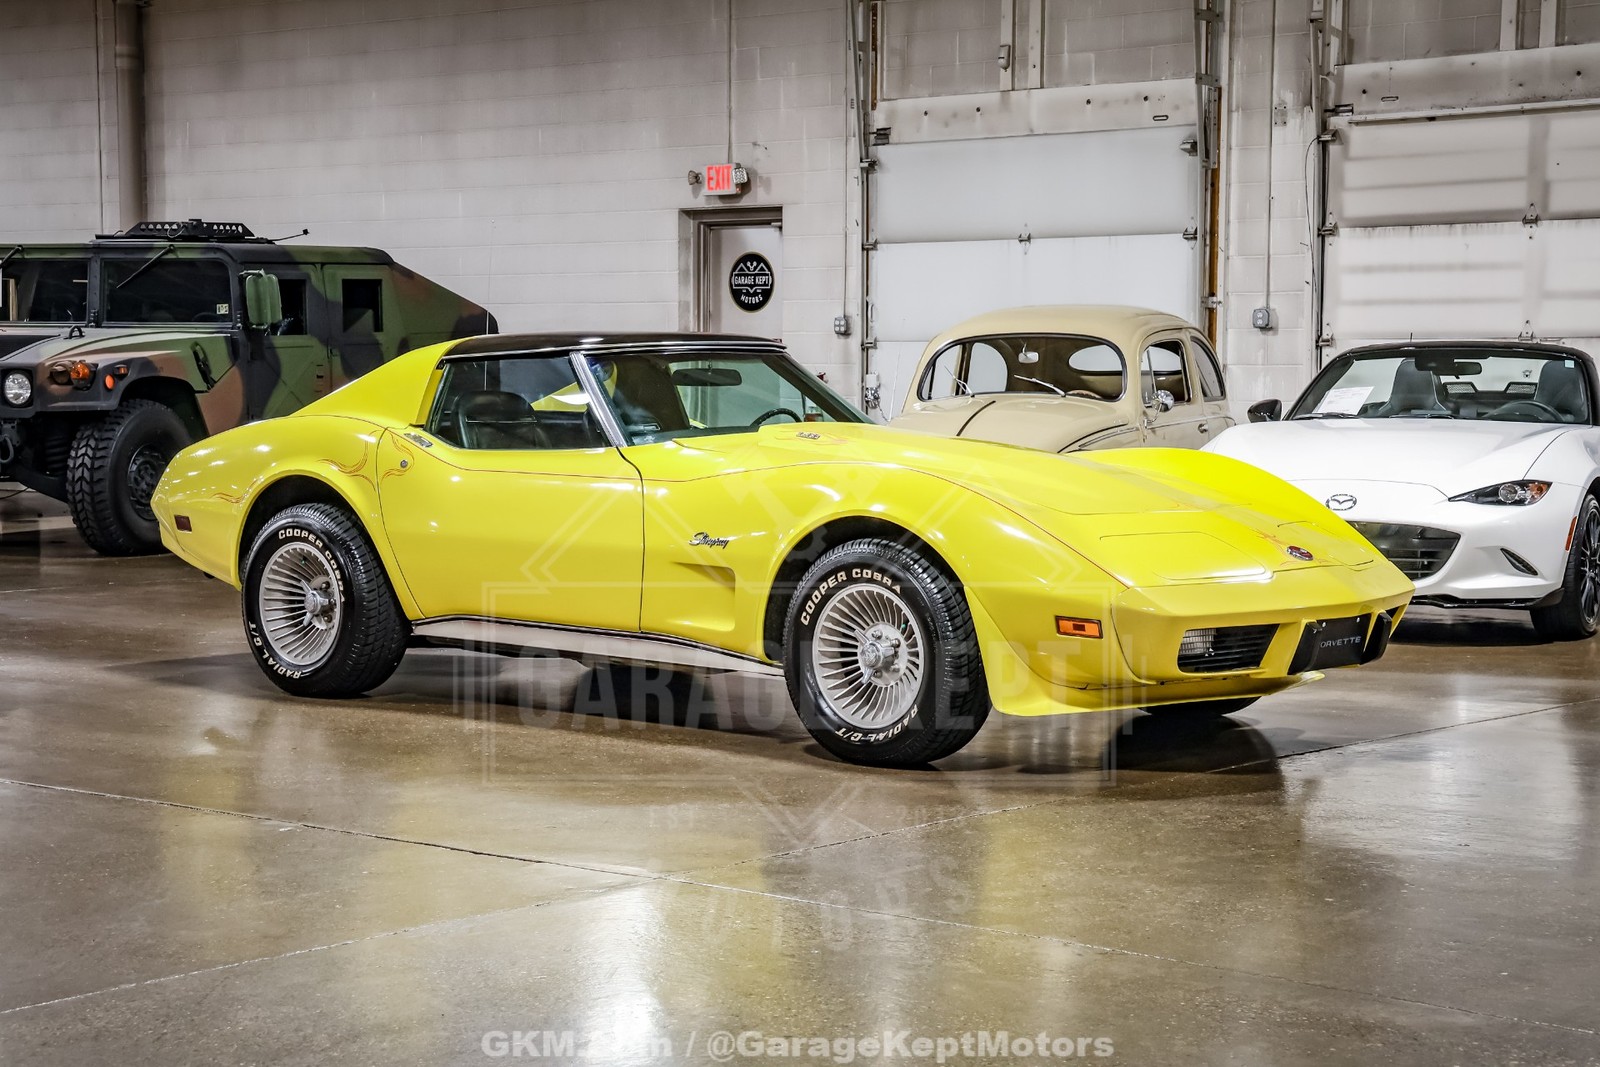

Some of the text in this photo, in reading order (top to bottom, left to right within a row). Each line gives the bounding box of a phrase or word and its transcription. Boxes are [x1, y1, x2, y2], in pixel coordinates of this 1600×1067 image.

[706, 165, 732, 191] EXIT
[734, 275, 769, 285] GARAGE KEPT
[740, 294, 763, 304] MOTORS
[688, 531, 729, 549] Stingray
[278, 528, 345, 602] COOPER COBRA
[800, 568, 901, 626] COOPER COBRA
[1320, 636, 1361, 648] ORVETTE
[262, 649, 302, 679] RADIAL
[867, 704, 918, 742] RADIAL
